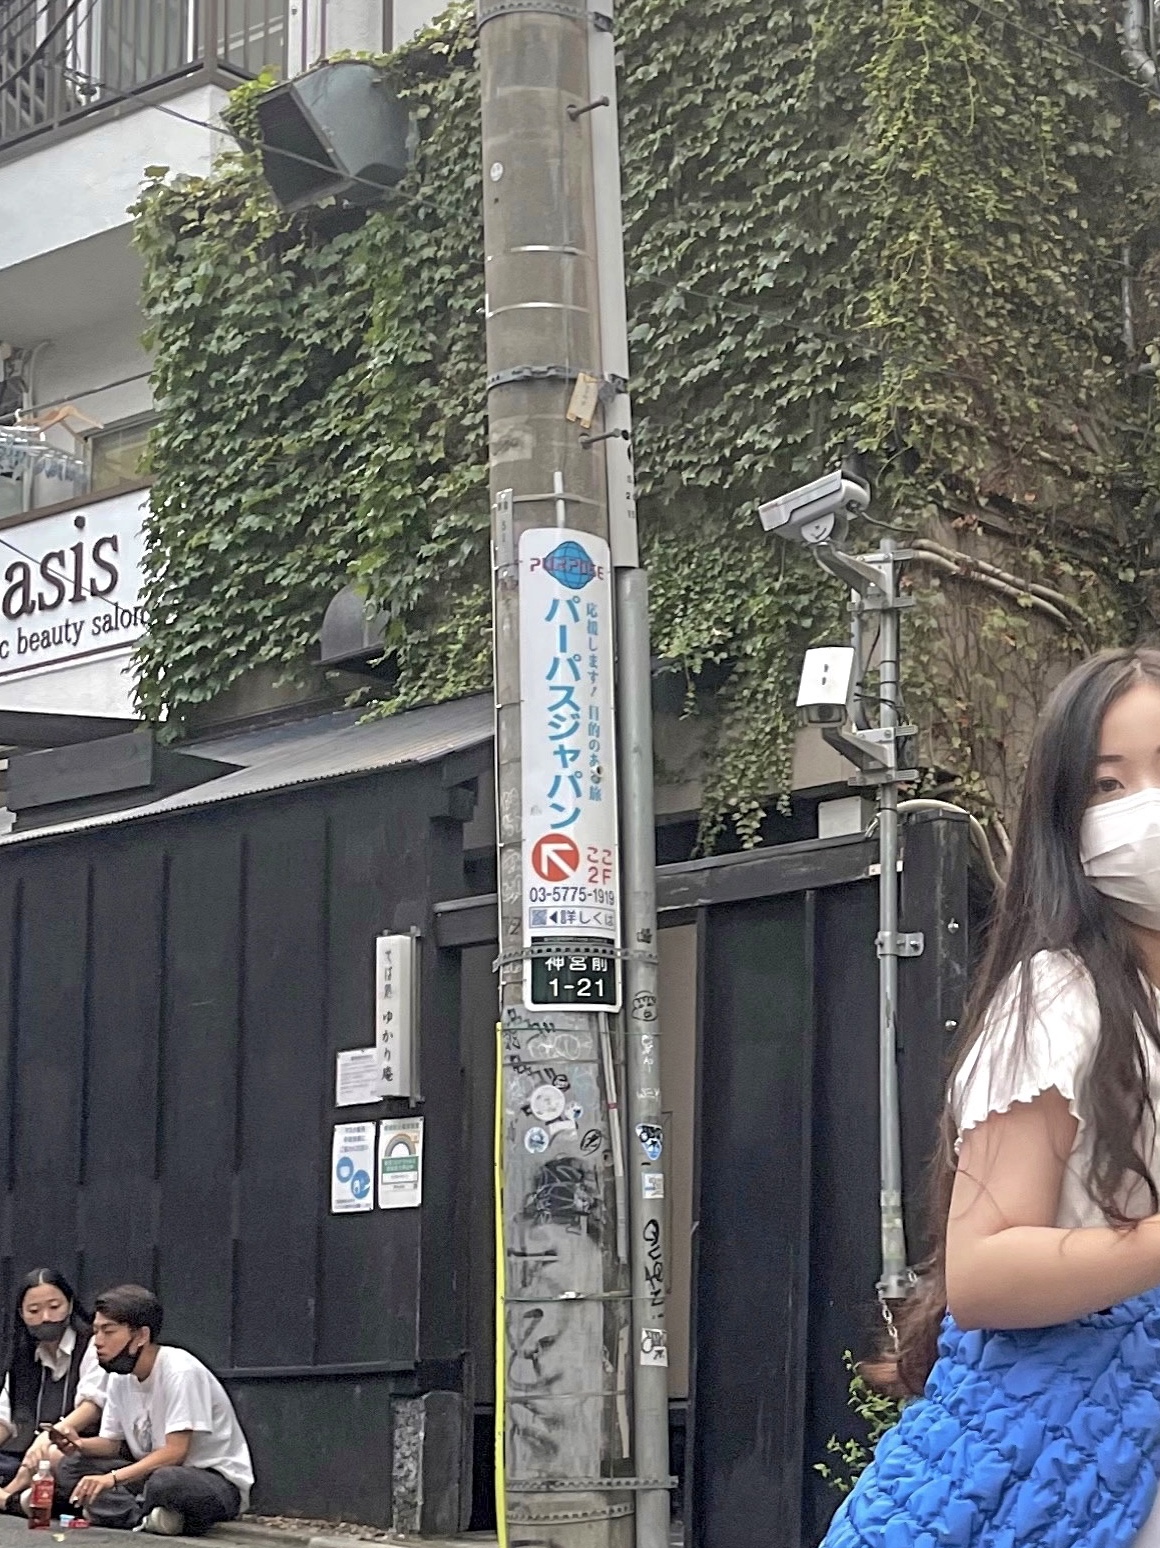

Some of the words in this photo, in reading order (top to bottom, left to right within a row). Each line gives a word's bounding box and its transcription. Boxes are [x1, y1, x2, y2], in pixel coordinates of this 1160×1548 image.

[2, 515, 119, 621] asis
[530, 557, 604, 581] PURPOSE
[17, 618, 85, 655] beauty
[544, 595, 583, 829] パーパスジャパン
[587, 846, 612, 866] ここ
[587, 866, 612, 885] 2F
[529, 886, 615, 906] 03-5775-1919
[560, 909, 614, 927] 詳しくは
[549, 977, 604, 997] 1-21
